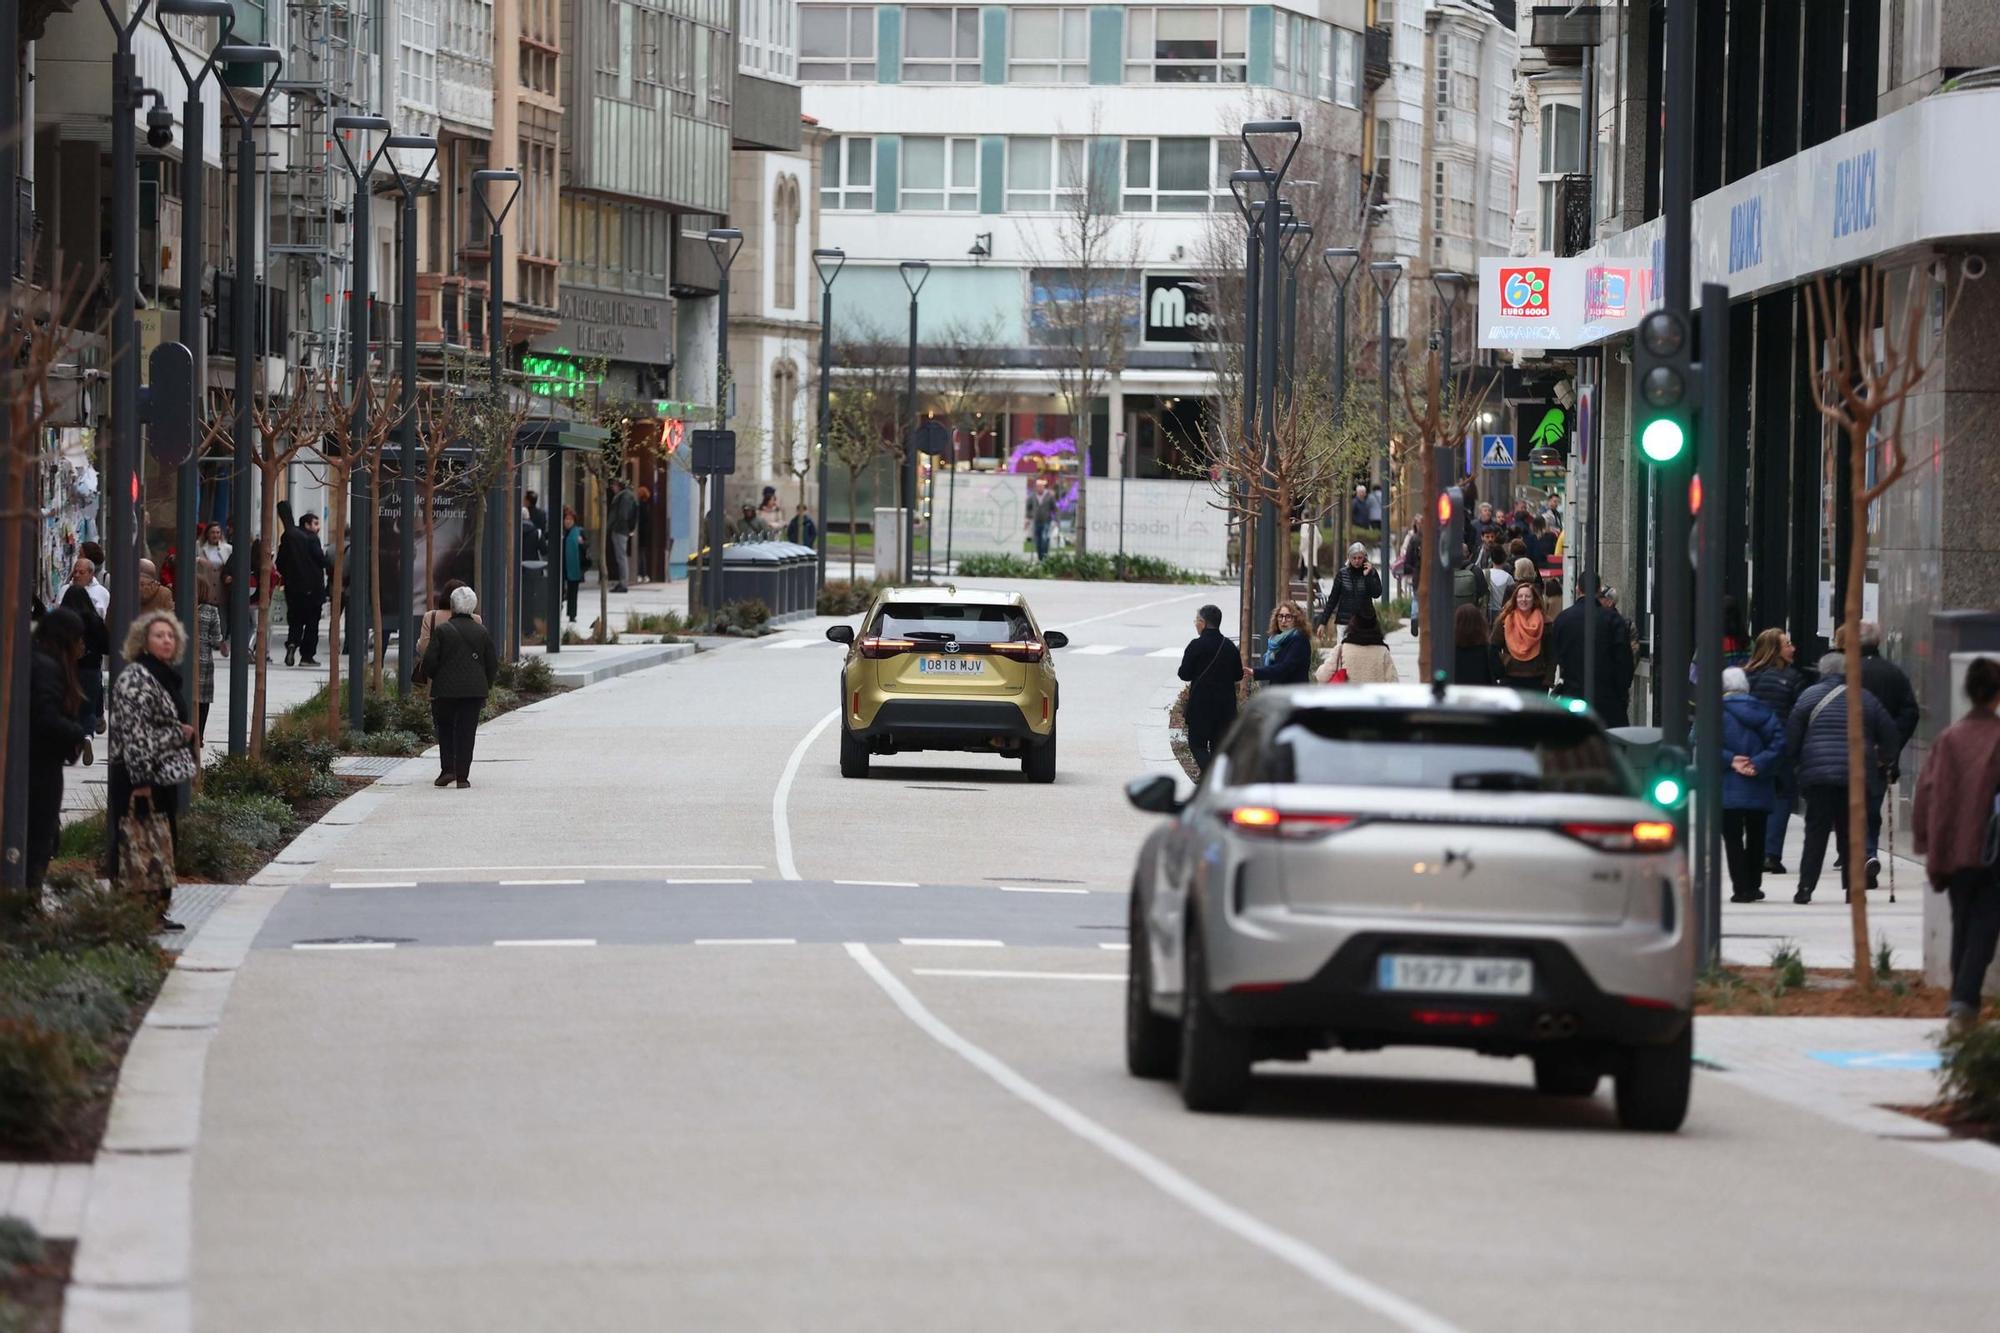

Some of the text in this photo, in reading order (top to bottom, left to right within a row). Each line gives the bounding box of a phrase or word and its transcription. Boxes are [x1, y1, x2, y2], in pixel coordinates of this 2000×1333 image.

[1833, 149, 1876, 238] ABANCA
[1728, 196, 1762, 274] ABANCA
[1502, 308, 1548, 316] EURO 6000
[431, 496, 454, 505] oñar.
[431, 508, 468, 519] onducir.
[927, 660, 957, 671] 0818
[960, 660, 982, 671] MJV
[1400, 961, 1464, 986] 1977
